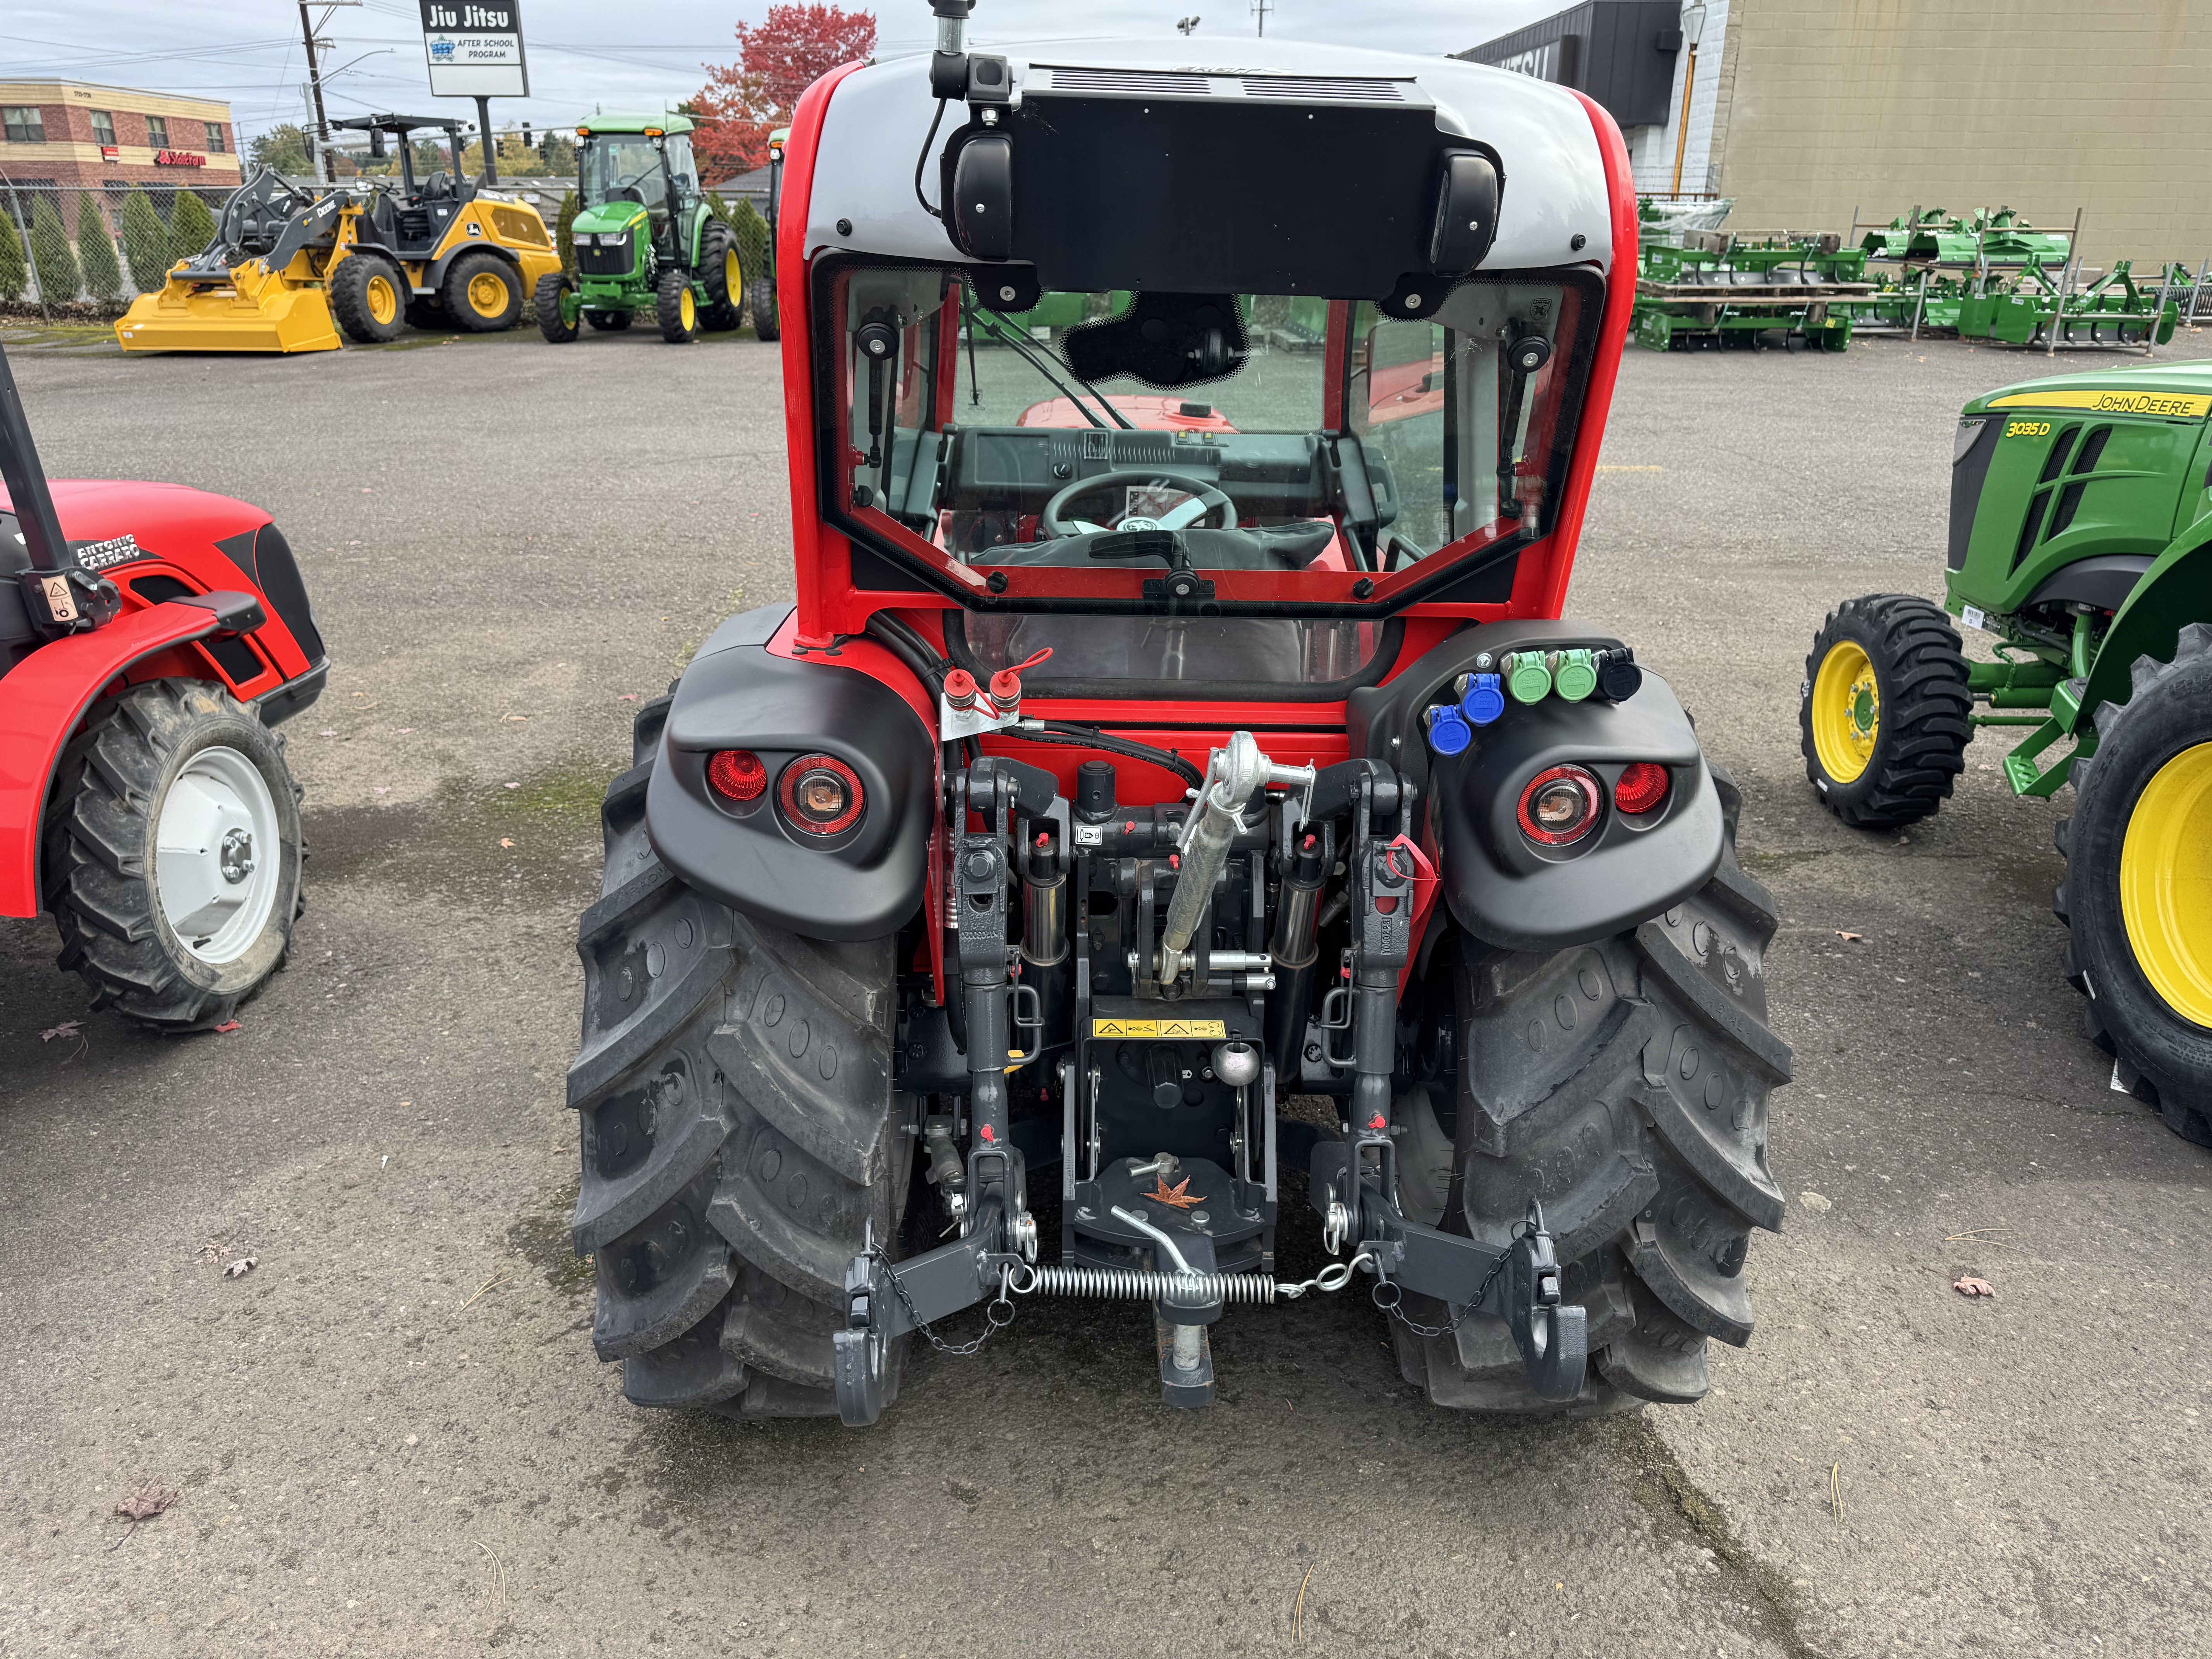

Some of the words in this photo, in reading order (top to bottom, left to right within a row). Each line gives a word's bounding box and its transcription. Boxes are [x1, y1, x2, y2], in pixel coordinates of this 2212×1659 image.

[429, 5, 457, 27] Jiu
[464, 5, 509, 27] Jitsu
[2092, 393, 2138, 410] JOHN
[2137, 396, 2195, 416] DEERE
[77, 534, 135, 558] ANTONIO
[80, 543, 140, 570] CARRARO
